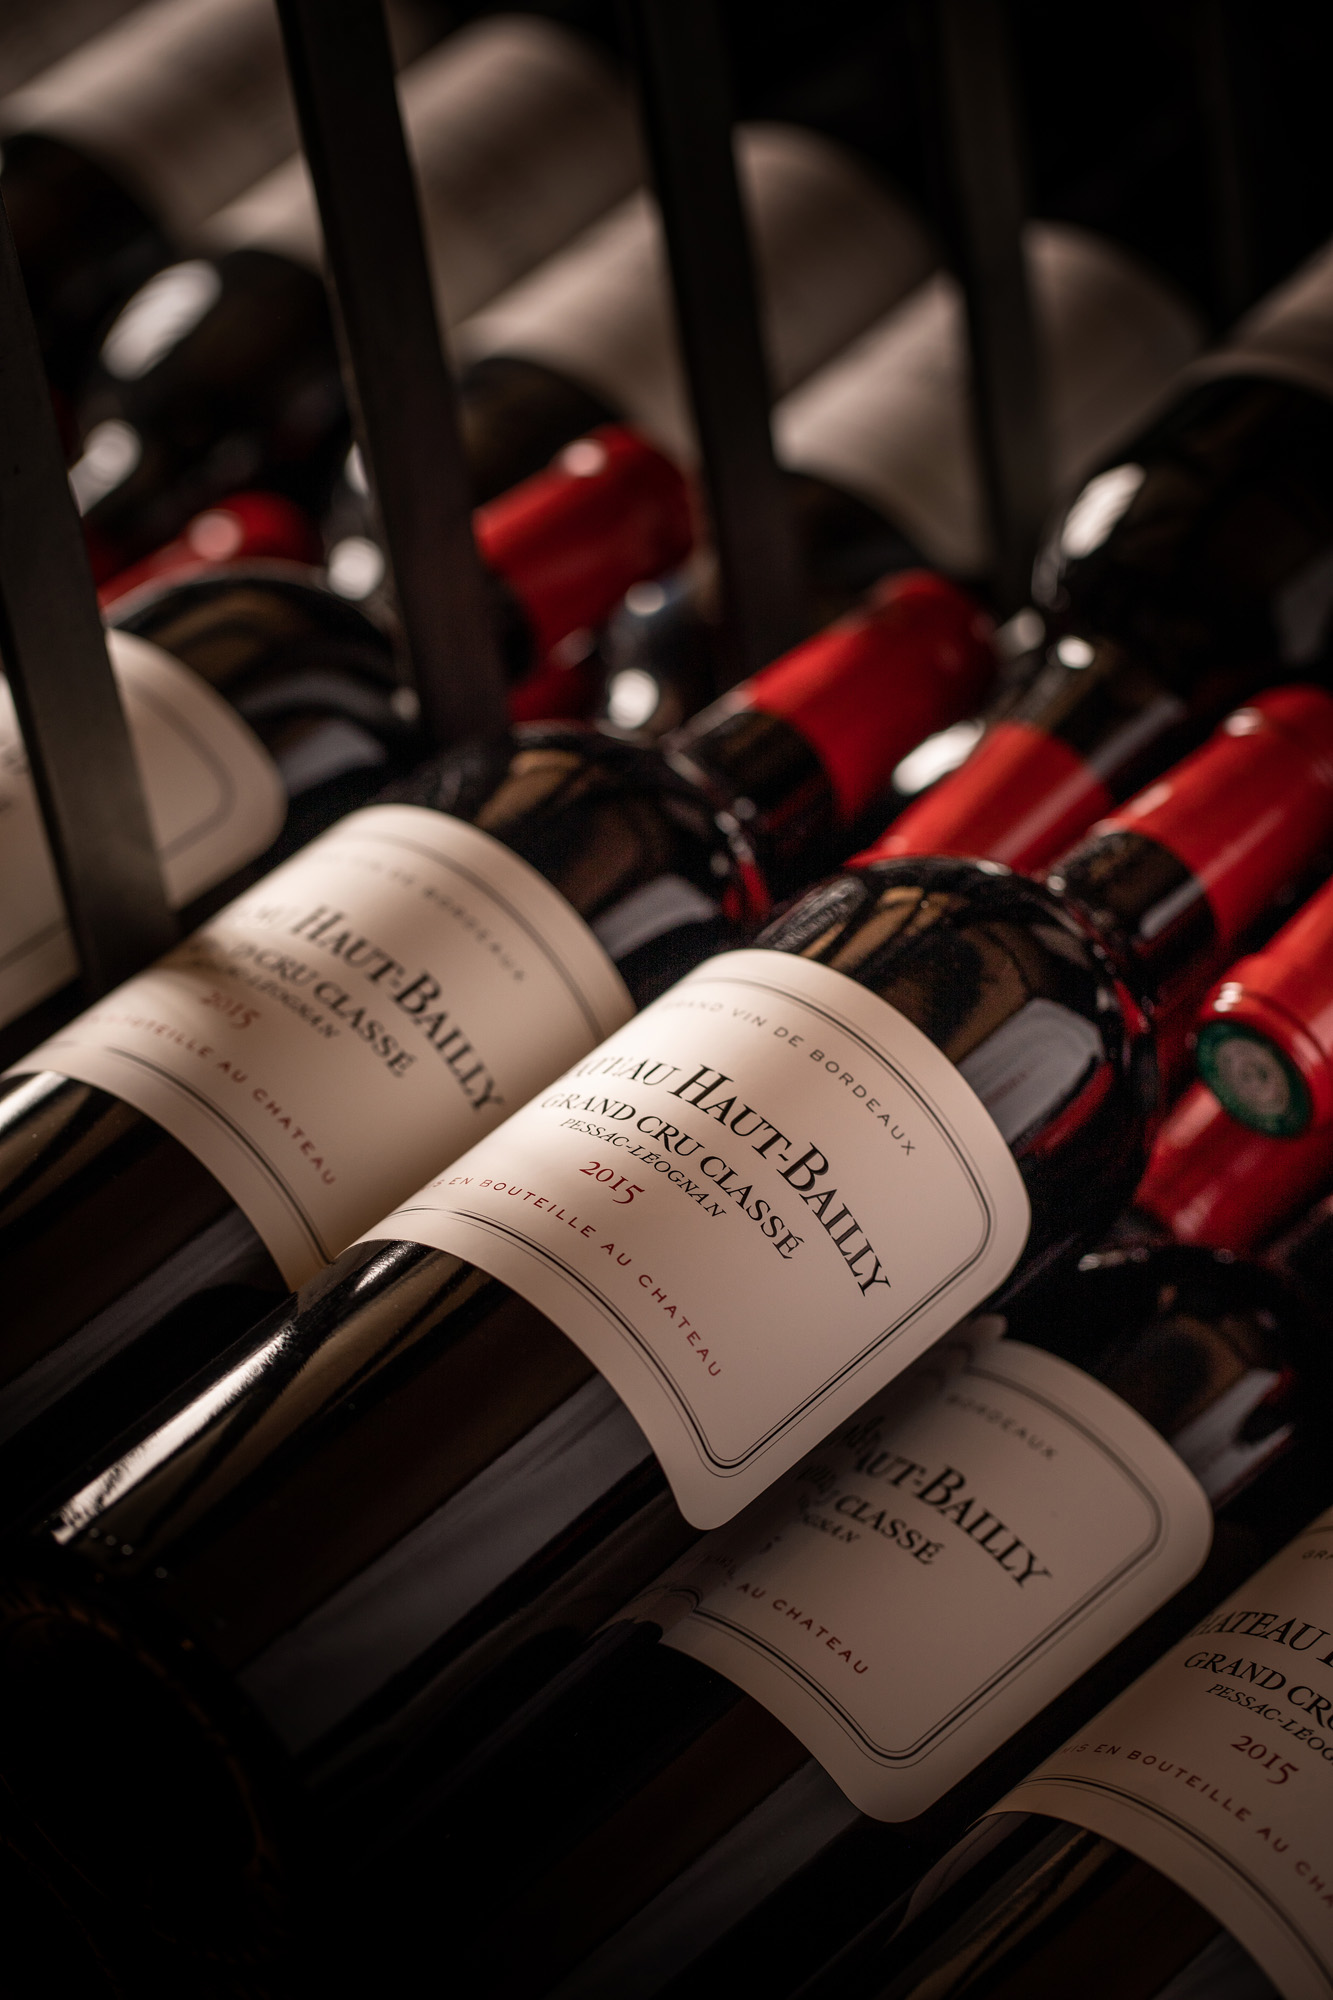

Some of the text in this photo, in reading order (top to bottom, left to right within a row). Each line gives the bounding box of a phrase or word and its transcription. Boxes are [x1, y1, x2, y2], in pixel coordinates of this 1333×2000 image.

[291, 904, 504, 1111] HAUT-BAILLY
[214, 1059, 249, 1085] AU
[251, 1086, 337, 1186] CHATEAU
[732, 1008, 768, 1028] VIN
[772, 1025, 805, 1049] DE
[808, 1047, 917, 1156] BORDEAUX
[540, 1092, 805, 1260] GRAND CRU CLASSÉ
[559, 1117, 727, 1218] PESSAC-LÉOGNAN
[578, 1160, 646, 1205] 2015
[665, 1062, 892, 1297] HAUT-BAILLY
[448, 1176, 722, 1378] EN BOUTEILLE AU CHATEAU
[833, 1494, 946, 1566] CLASSÉ
[737, 1581, 869, 1675] AU CHATEAU
[1183, 1651, 1287, 1691] GRAND
[1093, 1743, 1123, 1756] EN
[1126, 1749, 1253, 1823] BOUTEILLE
[1256, 1826, 1290, 1854] AU
[1230, 1734, 1300, 1785] 2015
